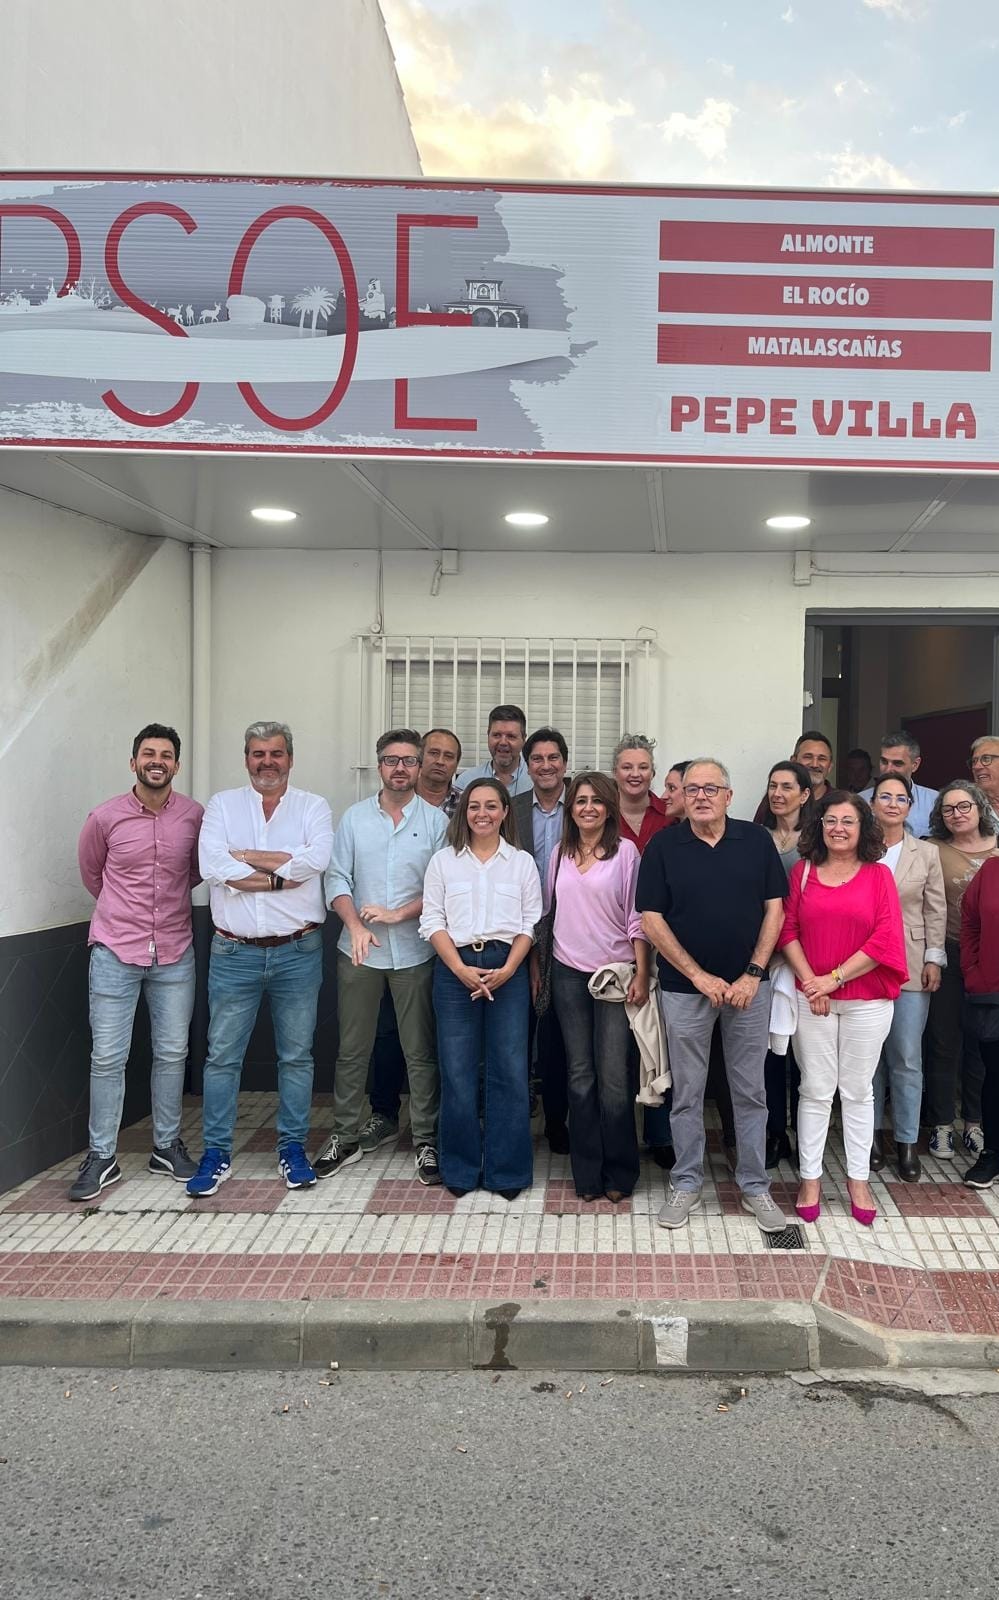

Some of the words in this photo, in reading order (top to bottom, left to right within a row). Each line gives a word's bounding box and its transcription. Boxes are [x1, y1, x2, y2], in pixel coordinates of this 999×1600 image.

[780, 234, 874, 254] ALMONTE
[783, 286, 803, 304] EL
[808, 283, 870, 306] ROCÍO
[747, 335, 903, 359] MATALASCAÑAS
[670, 395, 798, 435] PEPE
[811, 399, 977, 439] VILLA
